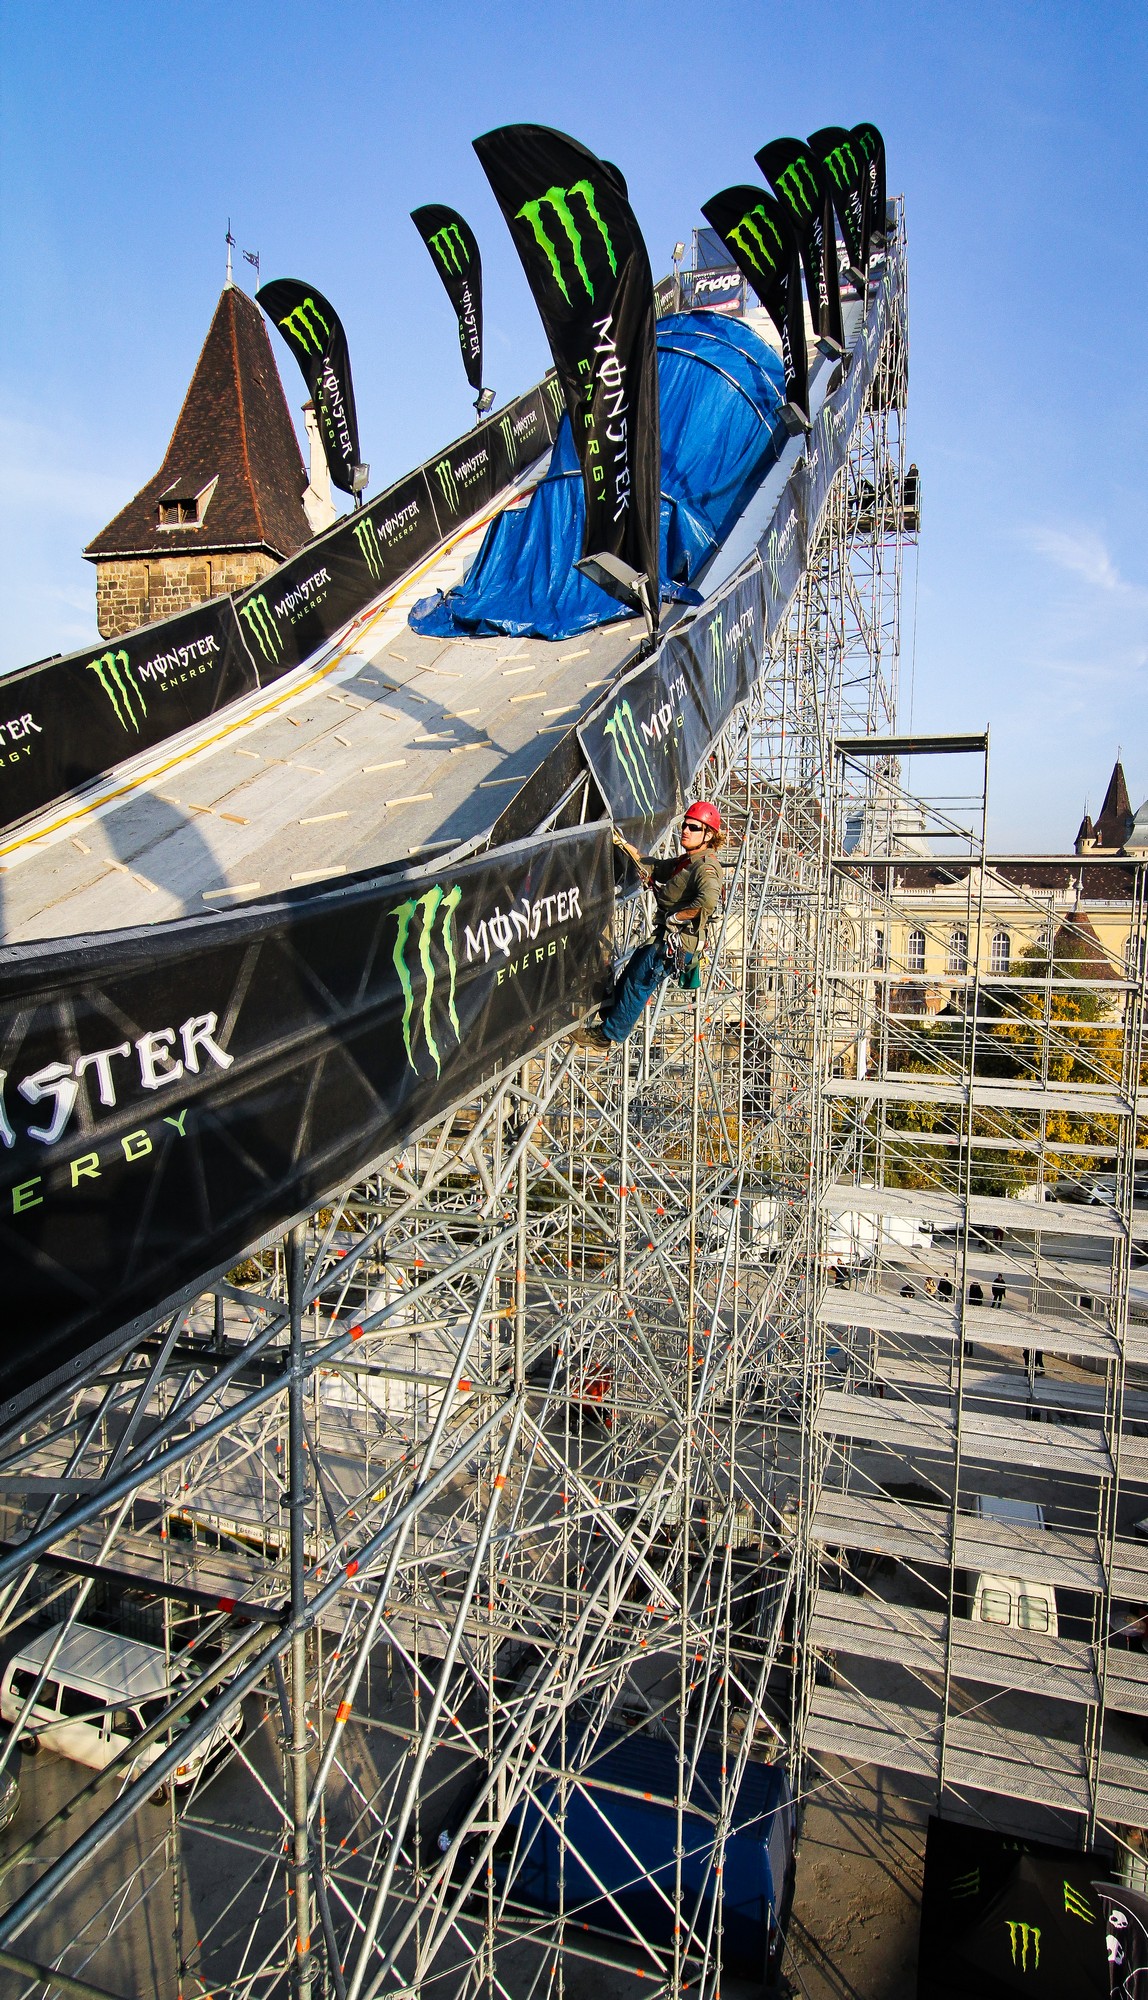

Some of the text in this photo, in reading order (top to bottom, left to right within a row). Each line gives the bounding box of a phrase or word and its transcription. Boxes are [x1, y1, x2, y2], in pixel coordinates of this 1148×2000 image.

[694, 274, 741, 294] Fridge
[317, 376, 337, 448] ENERGY
[323, 356, 353, 459] MONSTER
[512, 410, 538, 437] MONSTER
[577, 358, 606, 501] ENERGY
[454, 449, 489, 482] MONSTER
[464, 467, 487, 488] ENERGY
[376, 500, 420, 541] MONSTER
[388, 521, 418, 548] ENERGY
[274, 567, 332, 619] MONSTER
[291, 590, 329, 625] ENERGY
[137, 634, 221, 683] MONSTER
[160, 660, 215, 692] ENERGY
[464, 886, 582, 963] MONSTER
[497, 935, 568, 986] ENERGY
[12, 1108, 188, 1215] ERGY
